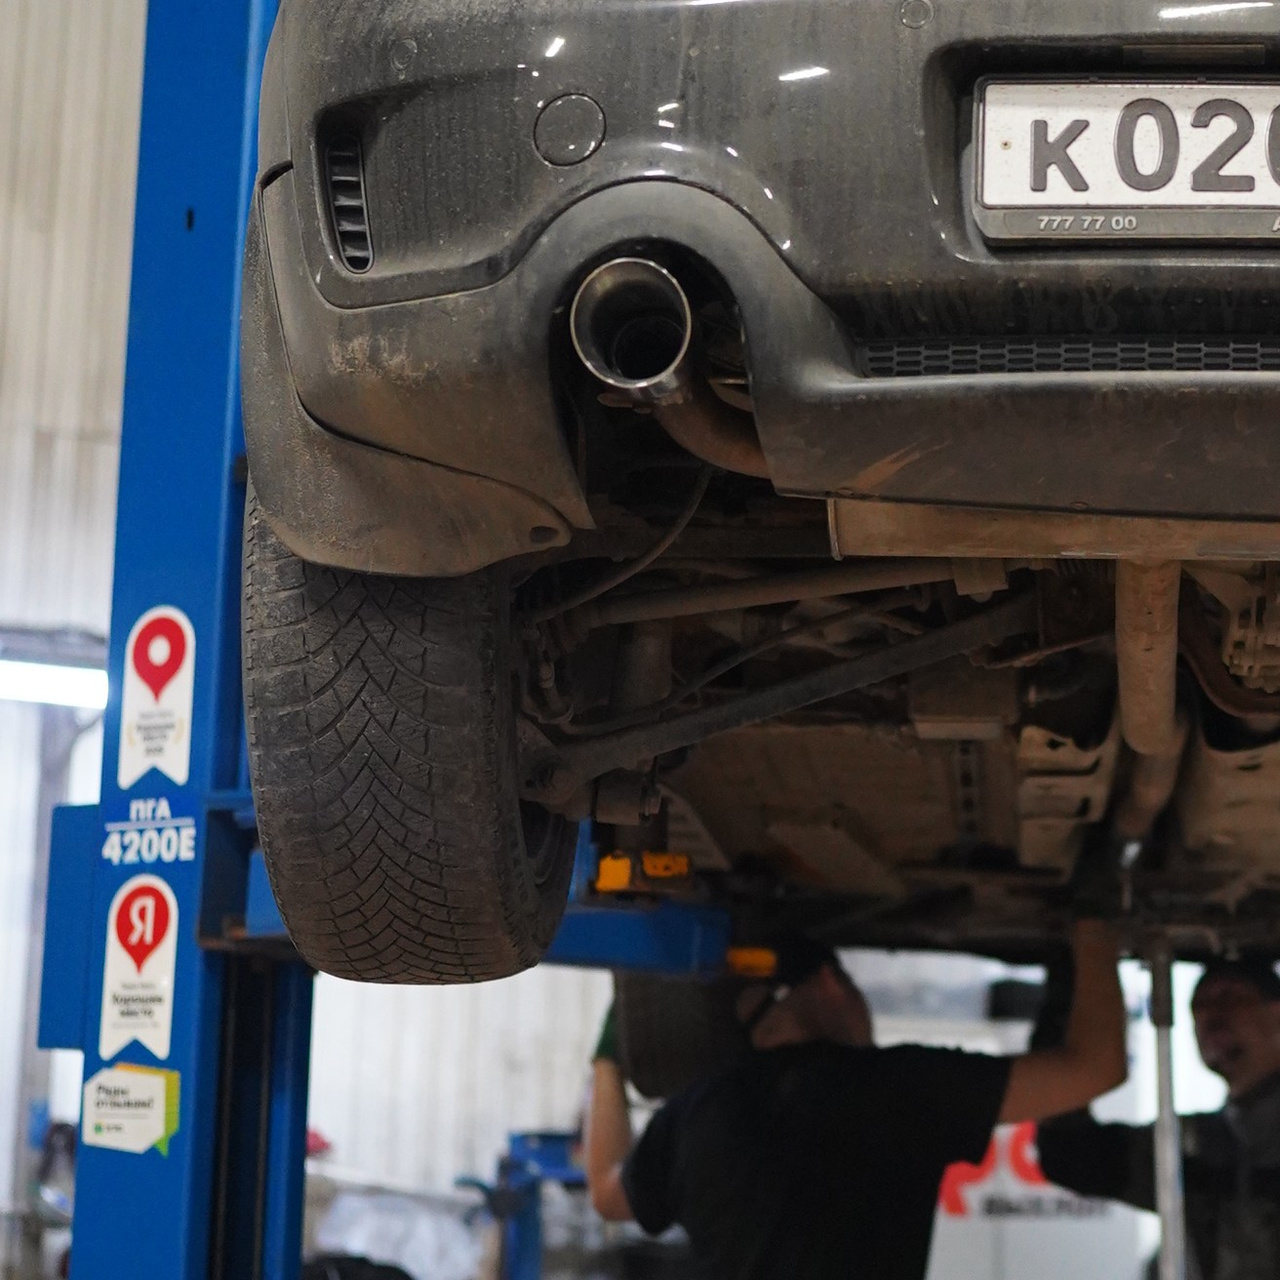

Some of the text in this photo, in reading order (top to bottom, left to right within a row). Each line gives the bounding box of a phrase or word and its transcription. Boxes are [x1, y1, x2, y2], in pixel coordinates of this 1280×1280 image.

[1038, 216, 1138, 231] 777 77 00
[101, 827, 197, 866] 4200E
[127, 895, 156, 947] Я
